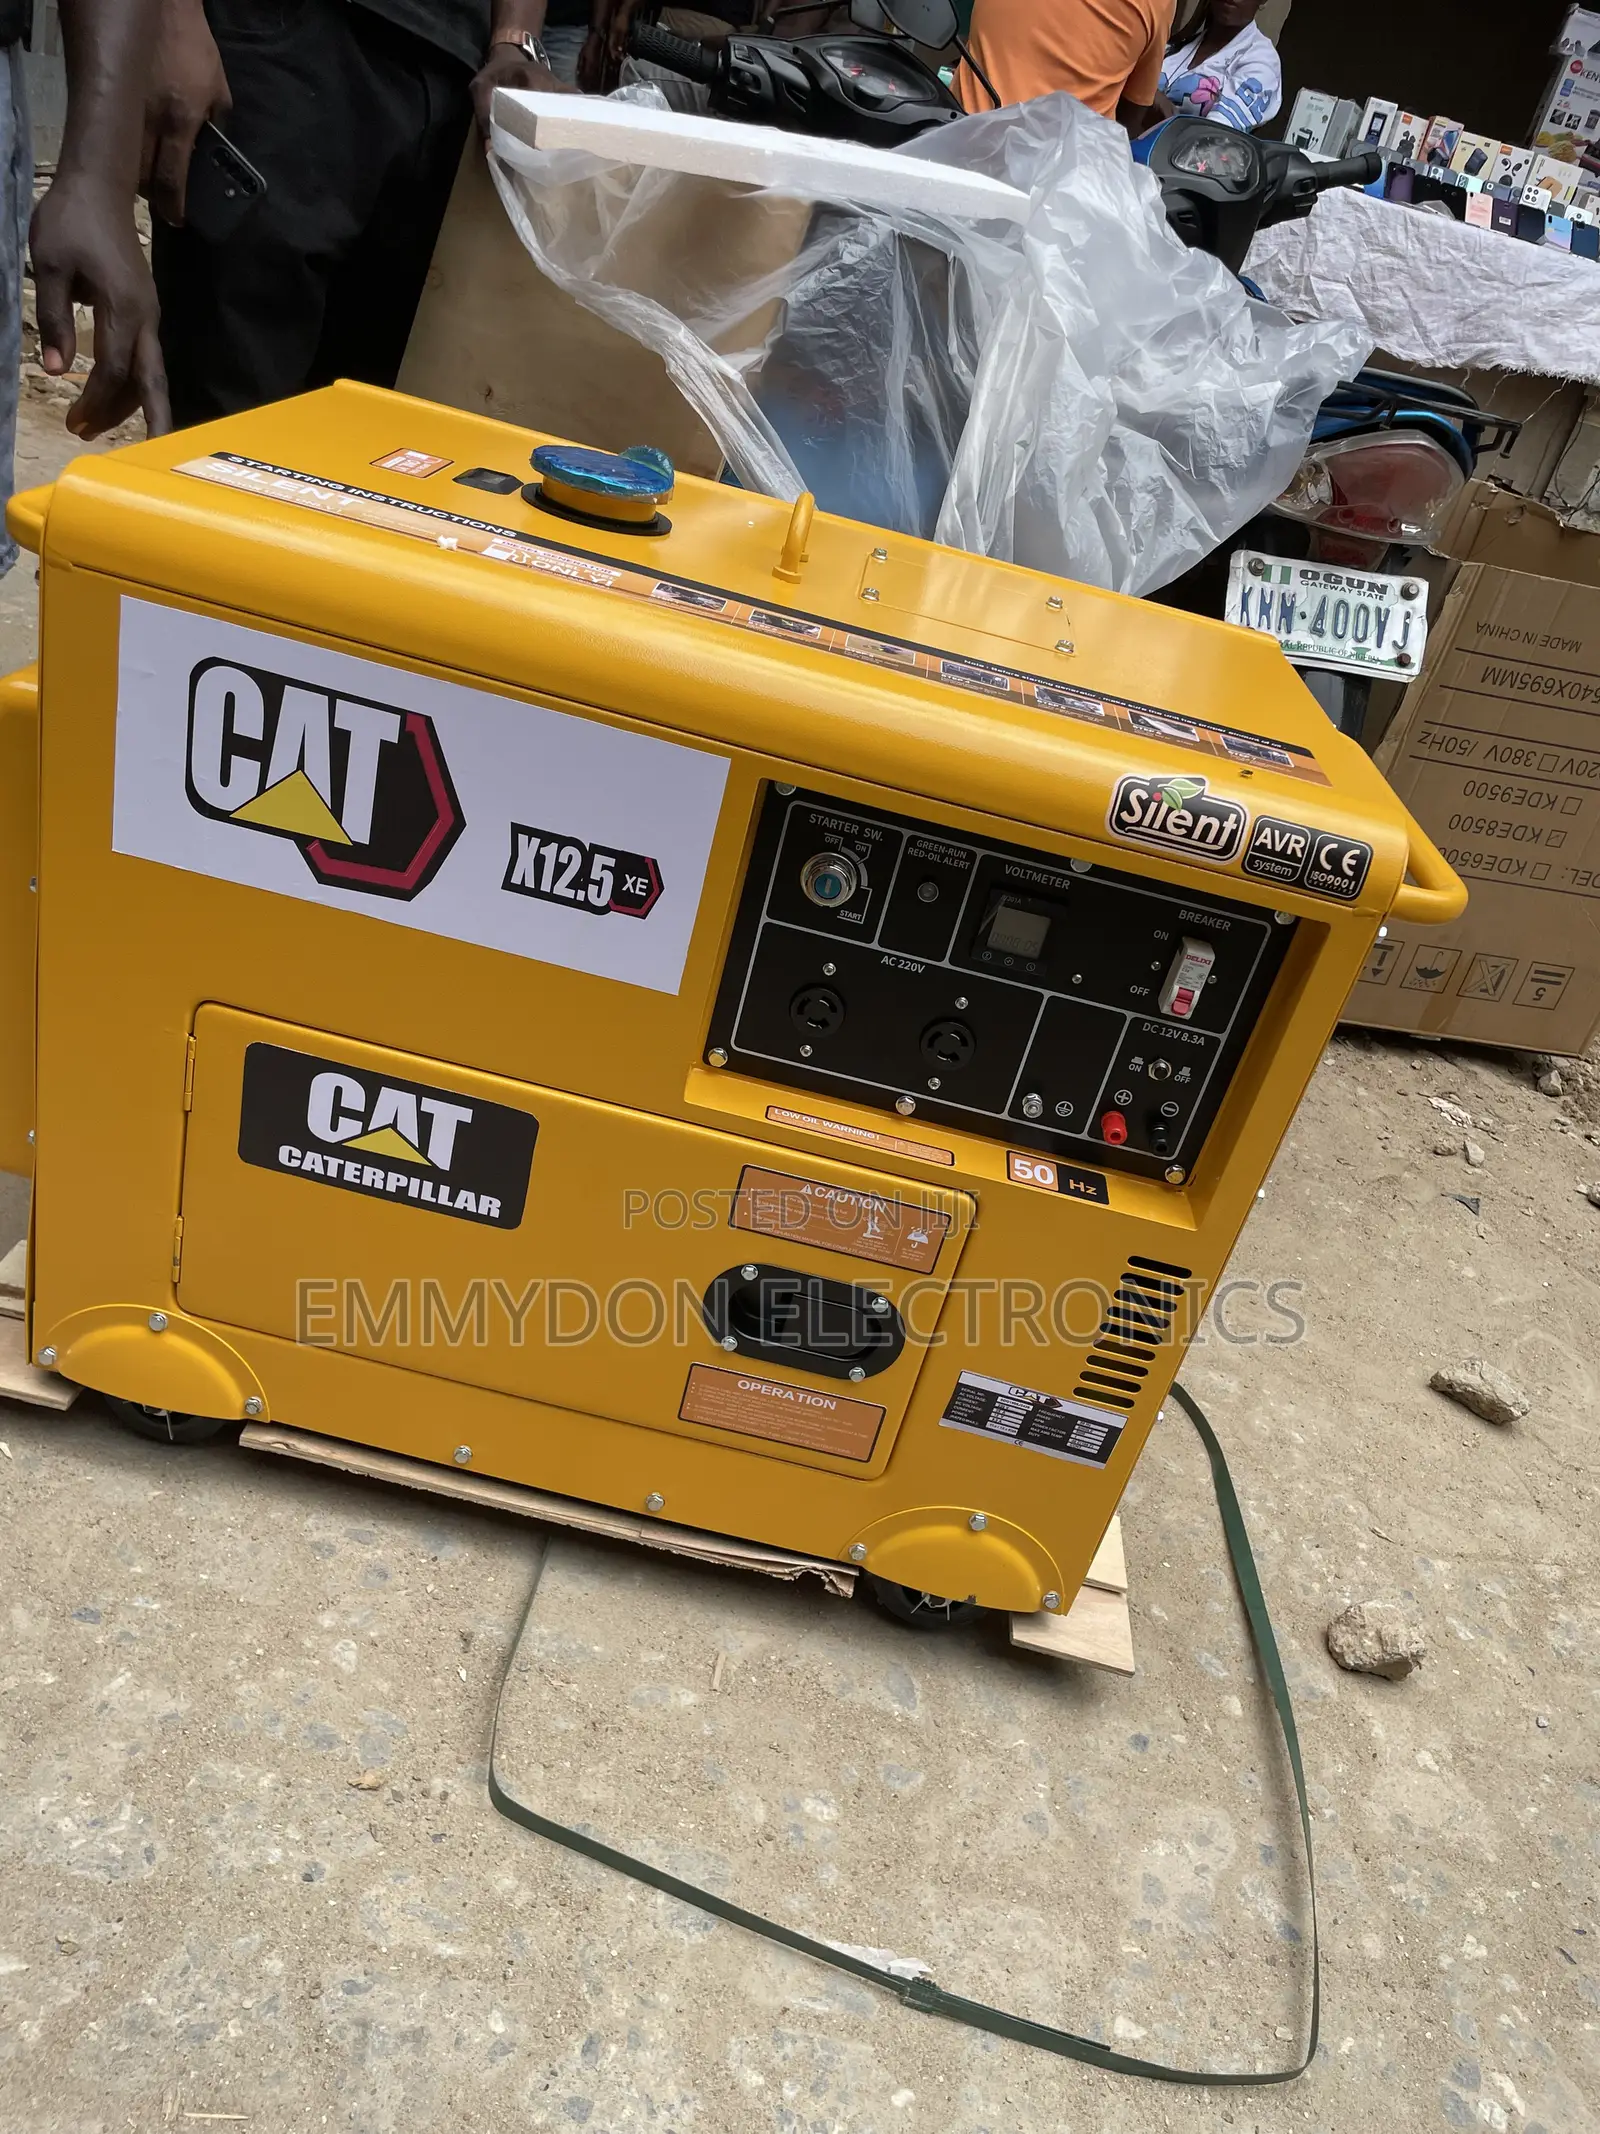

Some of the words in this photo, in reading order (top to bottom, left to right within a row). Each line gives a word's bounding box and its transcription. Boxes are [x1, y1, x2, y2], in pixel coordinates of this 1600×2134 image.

[205, 461, 366, 507] SILENT
[228, 456, 346, 491] STARTING
[347, 486, 518, 539] INSTRUCTIONS
[502, 541, 539, 553] DIESEL
[543, 552, 613, 574] GENERATOR
[531, 560, 614, 587] ONLY!
[1299, 568, 1389, 595] OGUN
[1300, 579, 1353, 595] GATEWAY
[1357, 589, 1385, 601] STATE
[1476, 621, 1521, 642] CHINA
[1523, 631, 1539, 645] IN
[1297, 642, 1338, 655] REPUBLIC
[1338, 648, 1348, 657] OF
[1541, 634, 1582, 654] MADE
[191, 665, 401, 846] CAT
[1483, 744, 1537, 767] 380V
[1559, 758, 1600, 779] 20V
[1463, 780, 1558, 811] KDE9500
[809, 813, 859, 835] STARTER
[863, 827, 884, 842] SW.
[1120, 787, 1238, 848] Silent
[1448, 813, 1543, 844] KDE8500
[824, 835, 840, 846] OFF
[855, 843, 867, 853] ON
[916, 839, 967, 860] GREEN-RUN
[1255, 827, 1306, 858] AVR
[516, 832, 616, 907] X12.5
[622, 872, 649, 897] XE
[907, 847, 942, 863] RED-OIL
[943, 855, 971, 870] ALERT
[1253, 859, 1292, 877] system
[1319, 843, 1361, 877] CE
[1003, 864, 1071, 891] VOLTMETER
[1310, 870, 1356, 891] ISO9001
[839, 910, 863, 922] START
[1178, 909, 1232, 932] BREAKER
[1153, 929, 1169, 942] ON
[880, 953, 897, 969] AC
[897, 957, 926, 974] 220V
[1185, 954, 1212, 966] DELIXI
[1129, 984, 1150, 997] OFF
[1532, 987, 1547, 1001] 5
[1142, 1022, 1159, 1034] DC
[1159, 1026, 1181, 1040] 12V
[1180, 1031, 1205, 1046] 8.3A
[1128, 1063, 1142, 1073] ON
[1174, 1074, 1192, 1084] OFF
[307, 1072, 473, 1172] CAT
[774, 1108, 801, 1120] LOW
[802, 1114, 819, 1125] OIL
[822, 1120, 880, 1140] WARNING!
[278, 1144, 501, 1219] CATERPILLAR
[1013, 1158, 1055, 1185] 50
[815, 1186, 887, 1213] CAUTION
[737, 1379, 837, 1411] OPERATION
[1009, 1386, 1051, 1404] CAT
